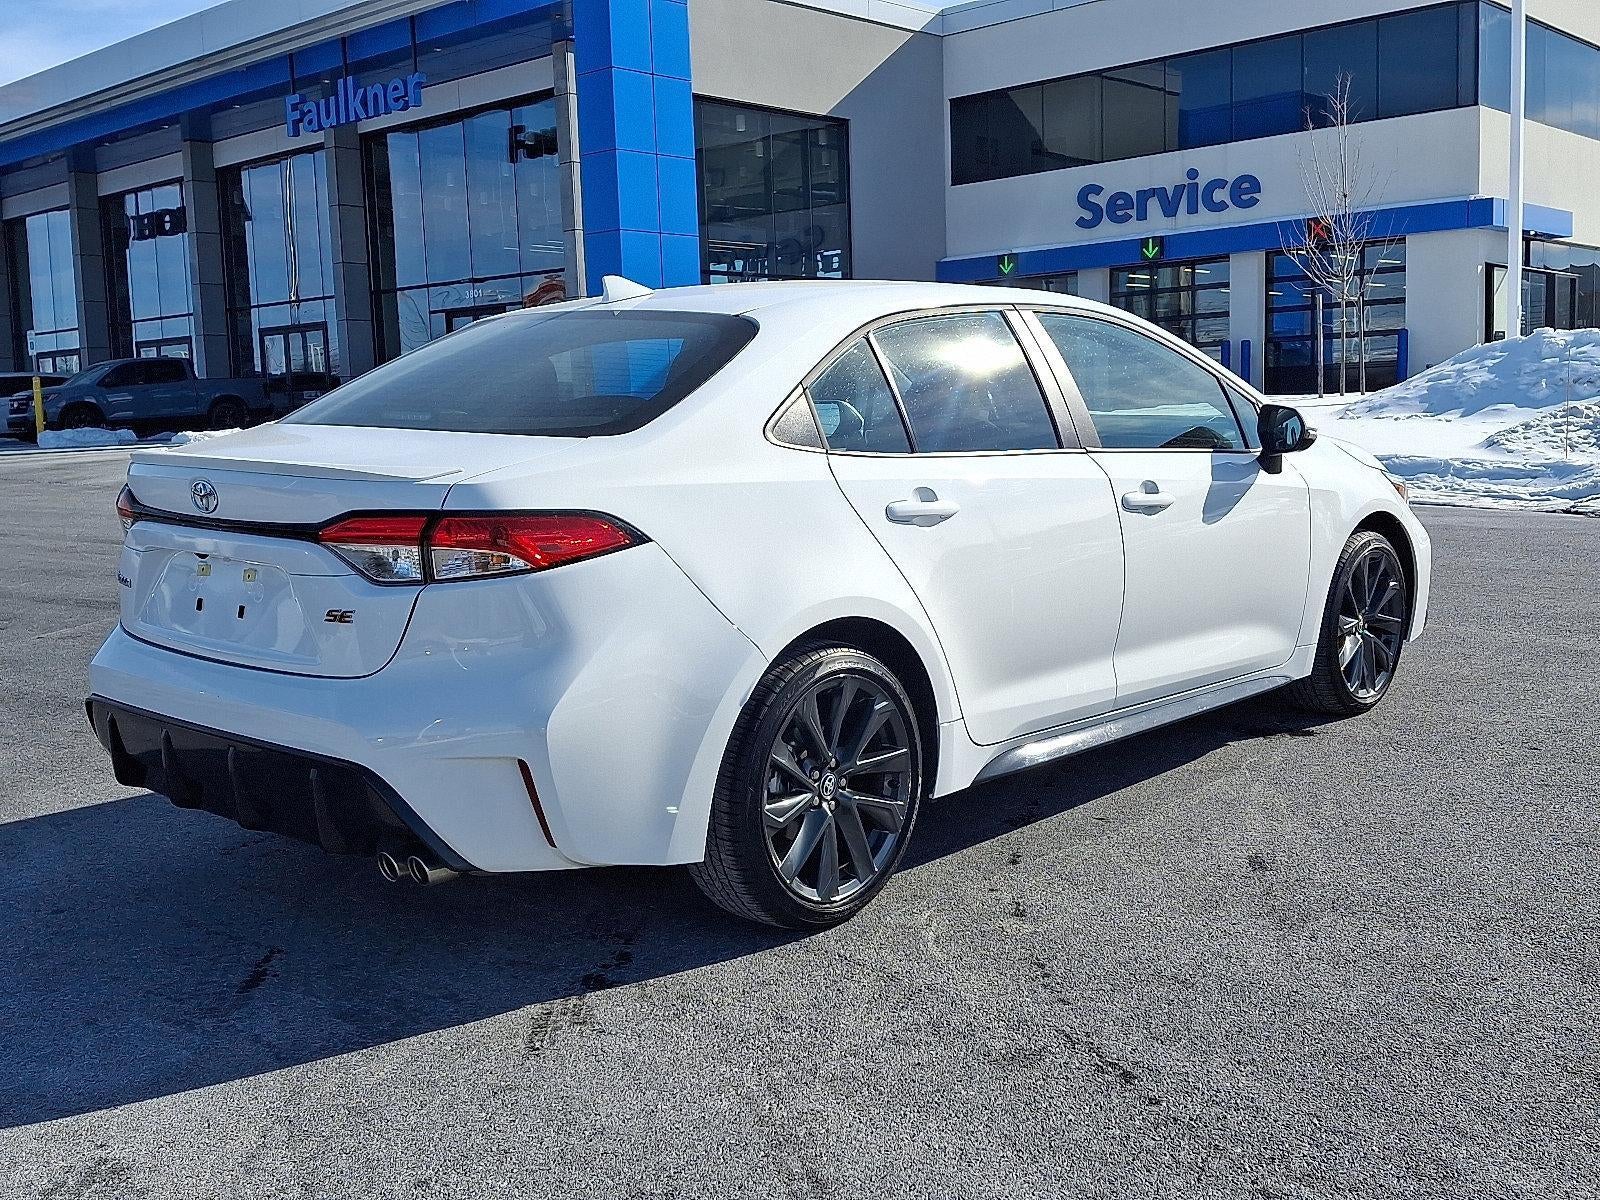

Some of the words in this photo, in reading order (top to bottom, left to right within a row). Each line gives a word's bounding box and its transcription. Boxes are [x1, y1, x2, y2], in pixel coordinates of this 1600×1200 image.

[285, 72, 426, 137] Faulkner
[1075, 168, 1262, 229] Service
[465, 288, 483, 299] 3801
[323, 609, 356, 624] SE
